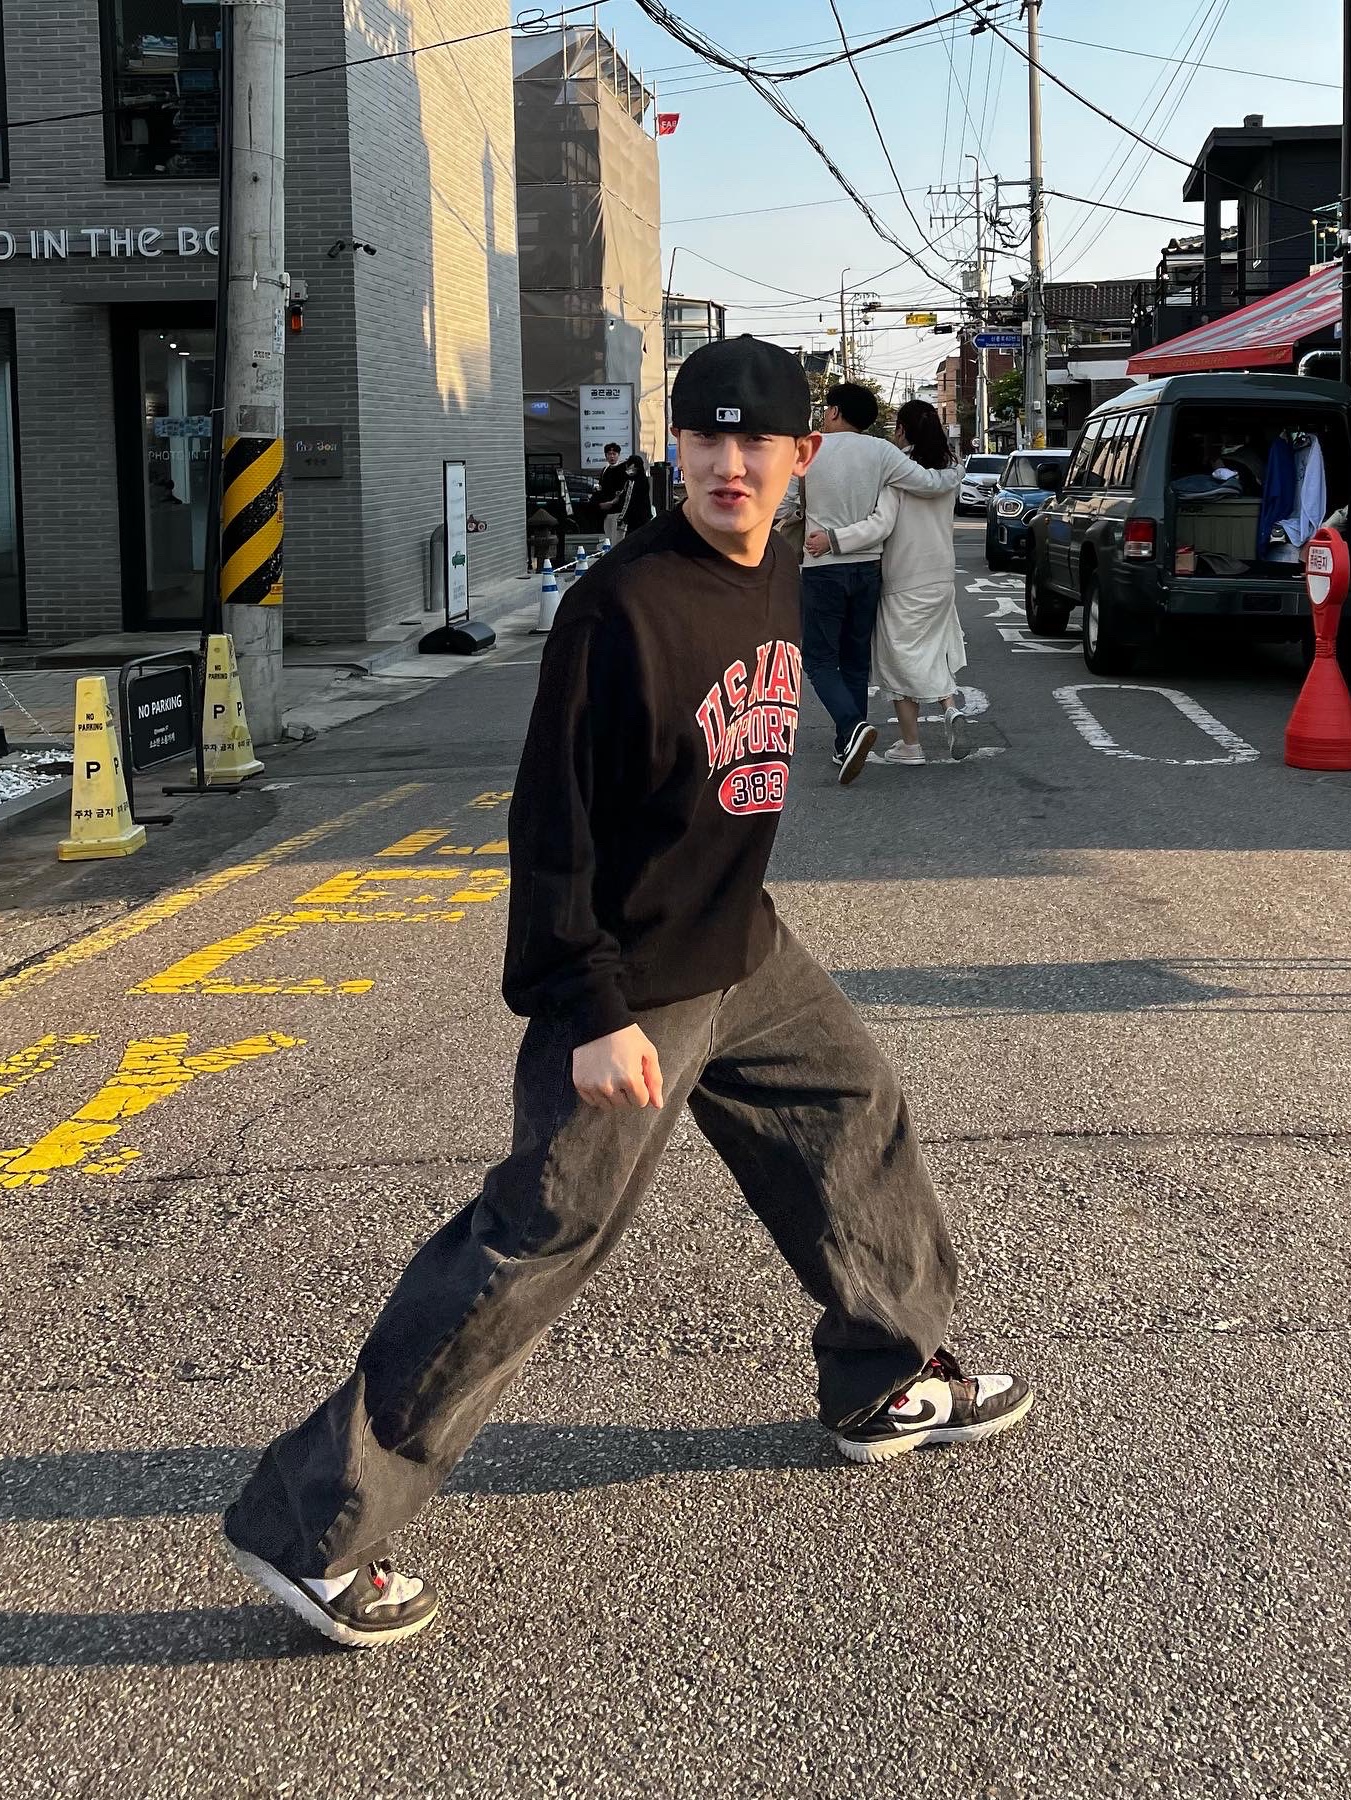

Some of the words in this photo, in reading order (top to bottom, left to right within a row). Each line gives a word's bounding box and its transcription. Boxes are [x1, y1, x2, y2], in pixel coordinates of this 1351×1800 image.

[30, 229, 69, 259] IN
[208, 672, 228, 680] PARKING
[138, 703, 150, 720] NO
[151, 694, 183, 716] PARKING
[213, 704, 226, 720] P
[85, 713, 95, 721] NO
[78, 722, 104, 732] PARKING
[86, 761, 101, 780] P
[731, 769, 785, 807] 383
[74, 809, 93, 819] 주차
[95, 808, 114, 818] 금지
